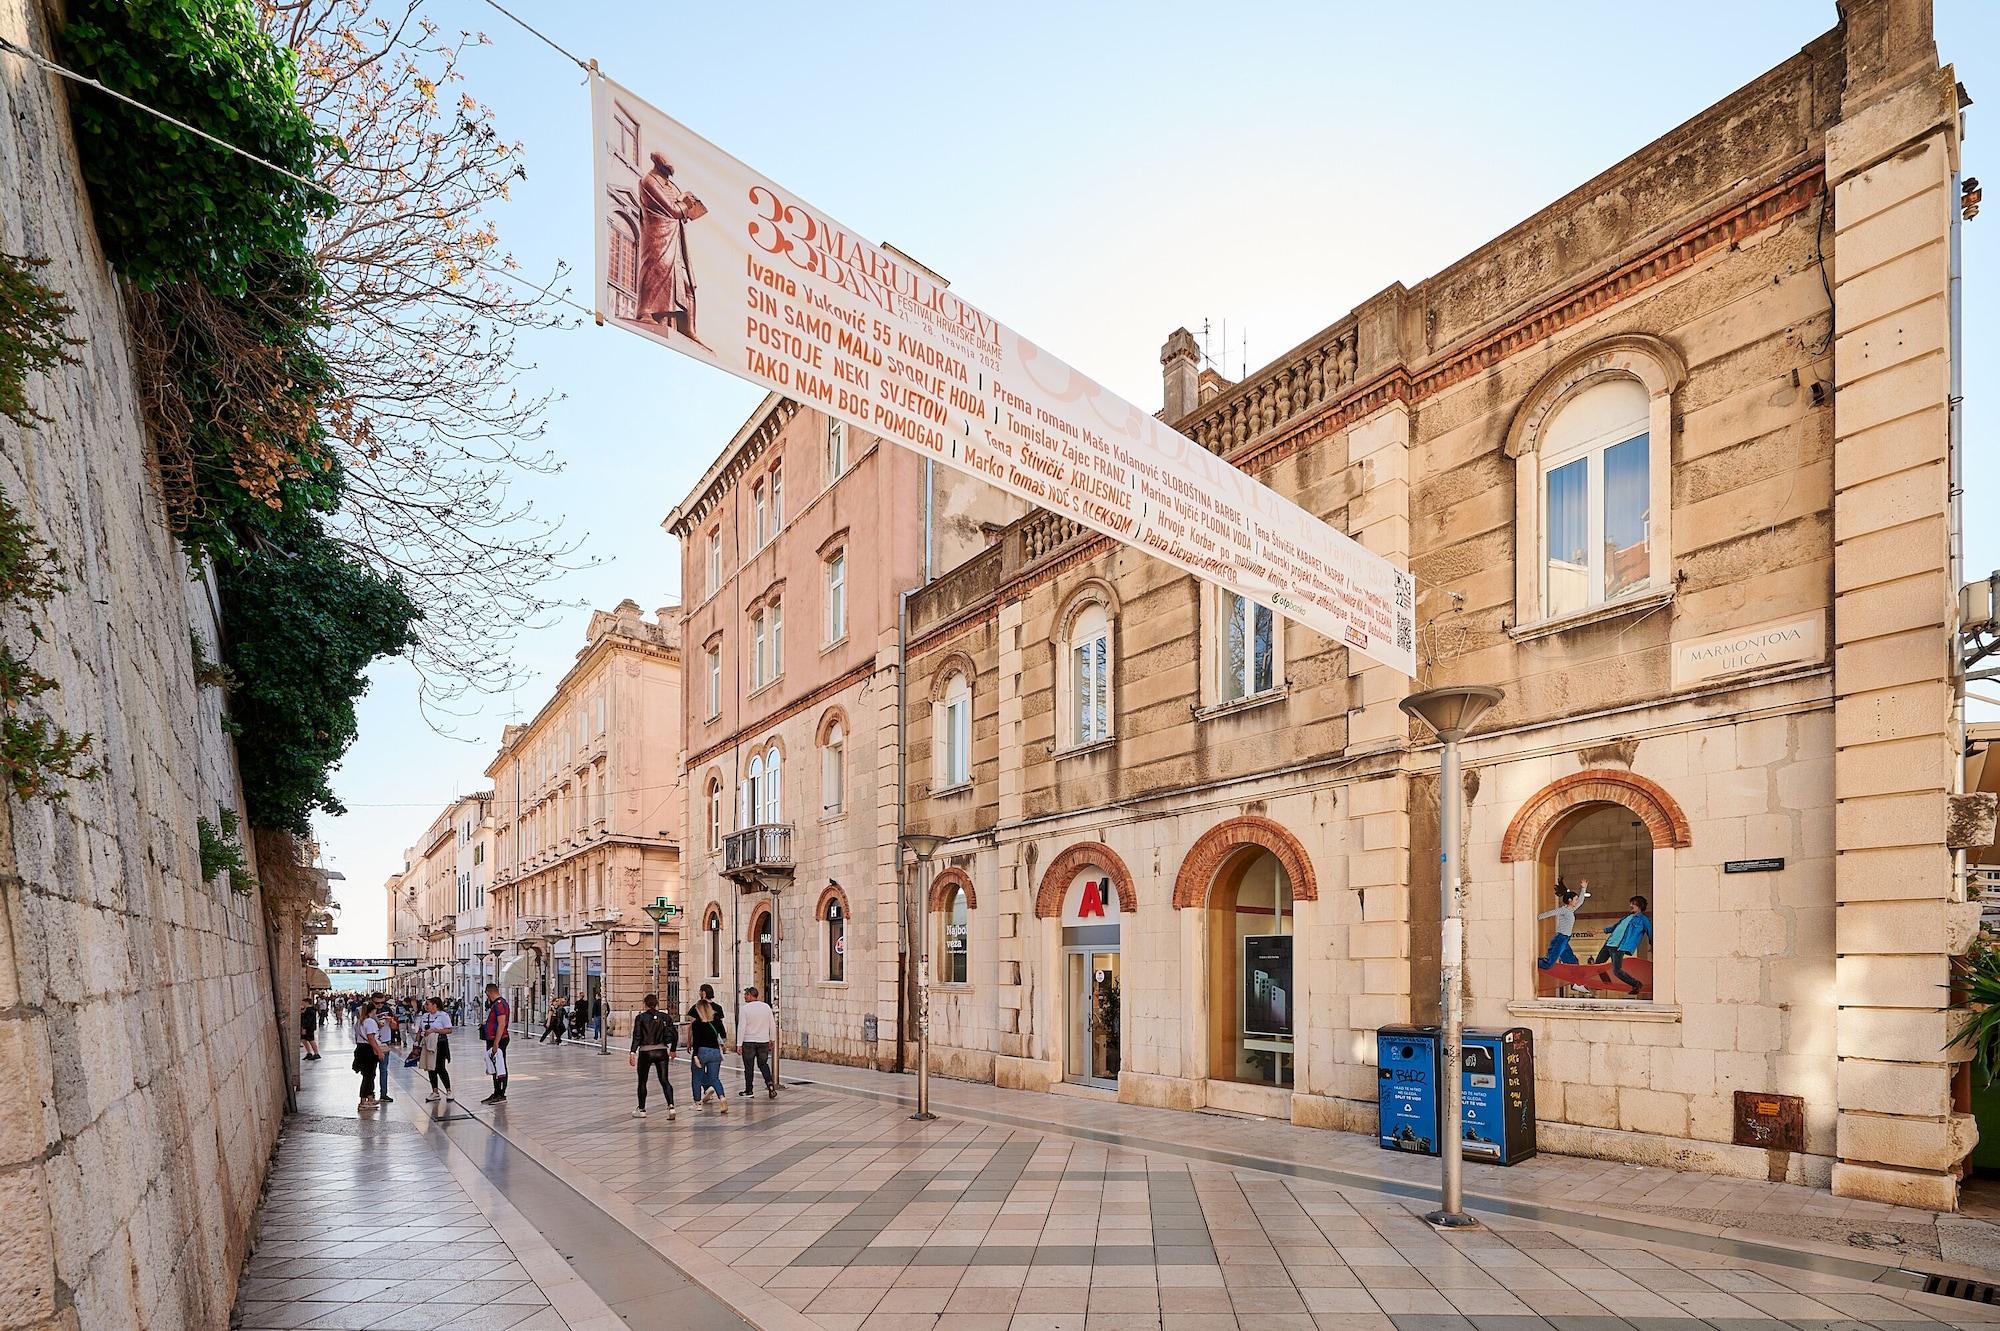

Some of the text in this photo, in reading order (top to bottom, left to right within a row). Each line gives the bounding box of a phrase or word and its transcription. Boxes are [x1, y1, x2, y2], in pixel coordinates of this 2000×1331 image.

[748, 186, 1001, 348] 33. MARULICEVI
[815, 249, 897, 316] DANI
[898, 295, 1002, 360] FESTIVAL HRVATSKE DRAME
[942, 334, 974, 358] travnja
[748, 254, 796, 297] Ivana
[803, 284, 865, 333] Vuković
[873, 320, 891, 345] 55
[899, 332, 967, 384] KVADRATA
[994, 381, 1031, 415] Prema
[1037, 408, 1078, 439] romanu
[1083, 428, 1109, 454] Maše
[1114, 444, 1158, 480] Kolanović
[1162, 471, 1212, 510] SLOBOŠTINA
[1215, 500, 1241, 526] BARBIE
[1254, 522, 1269, 542] Tena
[1297, 548, 1322, 572] KABARET
[748, 286, 777, 318] SIN
[784, 305, 831, 344] SAMO
[950, 385, 984, 419] HODA
[1007, 412, 1058, 452] Tomislav
[1062, 440, 1090, 467] Zajec
[1094, 456, 1125, 484] FRANZ
[1142, 480, 1171, 508] Marina
[1174, 497, 1198, 522] Vujčić
[1201, 511, 1230, 539] PLODNA
[1233, 528, 1251, 551] VODA
[748, 316, 822, 369] POSTOJE
[834, 357, 868, 390] NEKI
[881, 380, 947, 426] SVJETOVI
[985, 429, 1011, 458] Tena
[1020, 442, 1064, 480] Štivičić
[1071, 469, 1131, 510] KRIJESNICE
[1158, 510, 1184, 536] Hrvoje
[1190, 527, 1215, 552] Korbar
[1220, 547, 1229, 559] po
[746, 347, 788, 385] TAKO
[796, 369, 832, 404] NAM
[839, 388, 869, 419] BOG
[875, 404, 943, 452] POMOGAO
[965, 445, 1004, 478] Marko
[1009, 464, 1045, 496] Tomaš
[1048, 484, 1069, 507] NOĆ
[1073, 496, 1079, 512] S
[1083, 500, 1132, 534] ALEKSOM
[1143, 528, 1170, 554] Petra
[1200, 554, 1237, 584] SEMAFOR
[1691, 629, 1801, 661] MARMONTOVA
[1722, 652, 1767, 670] ULICA
[831, 906, 837, 917] H
[1078, 878, 1109, 918] A1
[761, 934, 773, 943] HAR
[946, 940, 962, 948] veza
